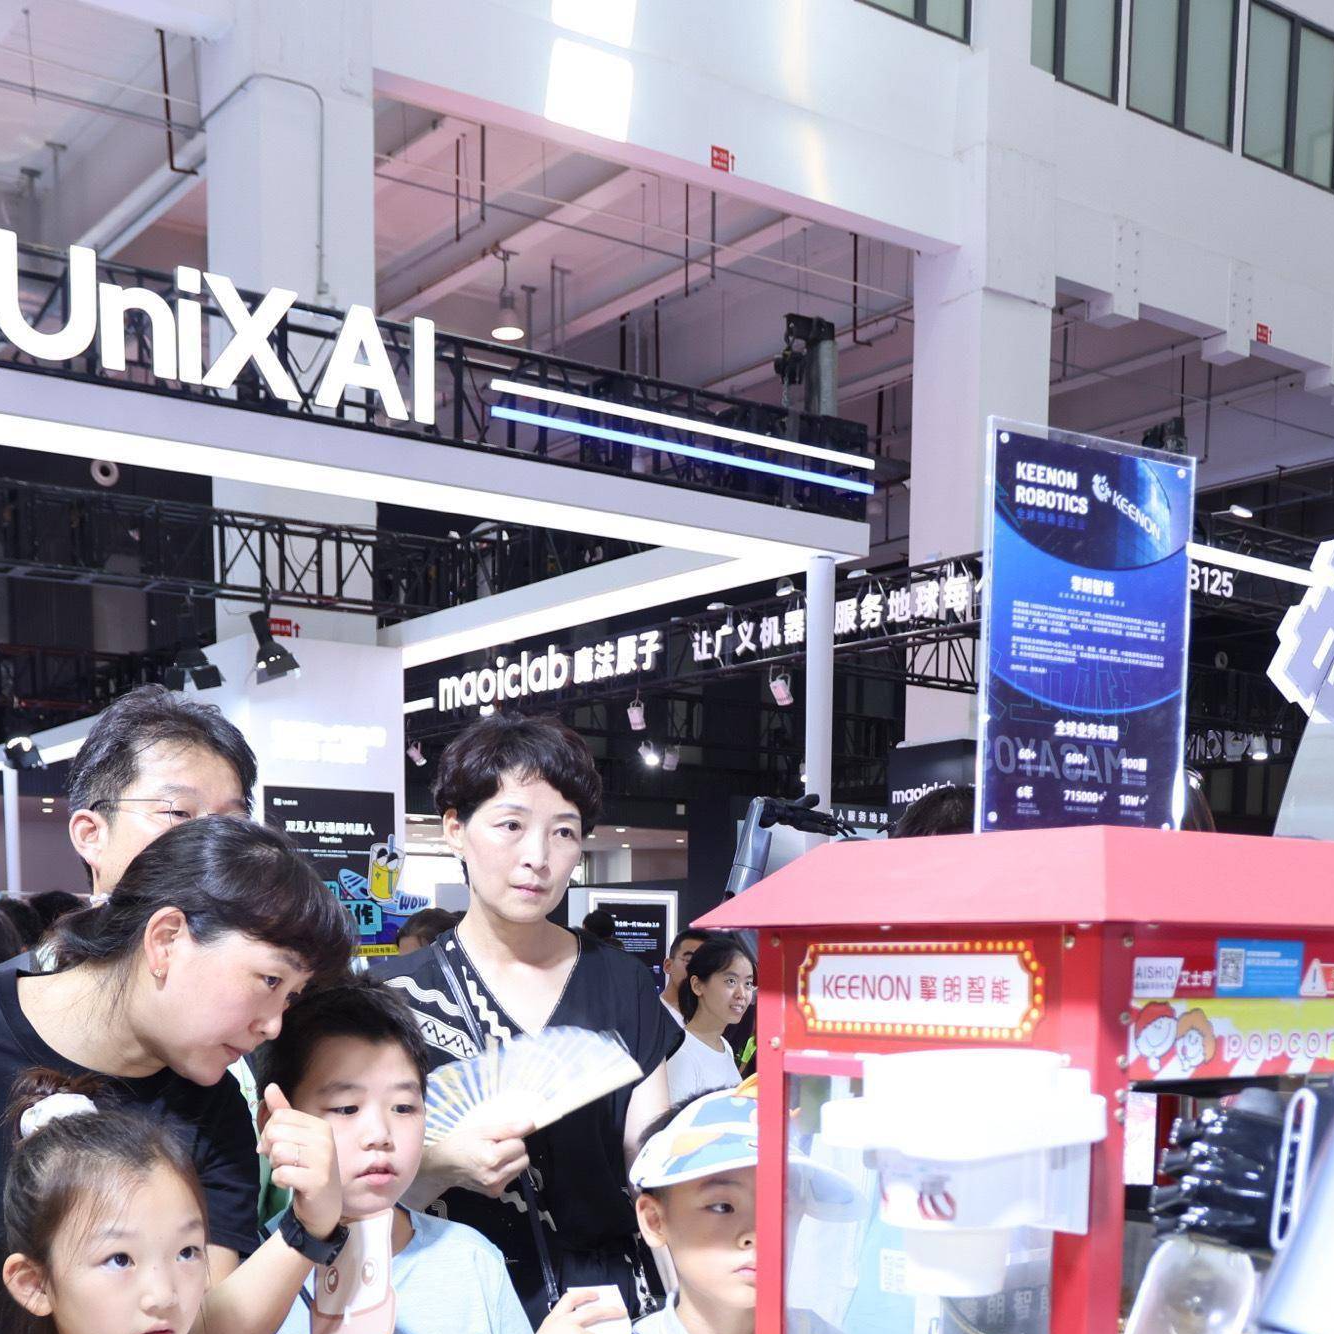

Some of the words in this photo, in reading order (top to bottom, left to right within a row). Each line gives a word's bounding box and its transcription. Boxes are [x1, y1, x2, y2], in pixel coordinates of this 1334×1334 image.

[1015, 460, 1078, 490] KEENON
[1014, 484, 1089, 515] ROBOTICS
[1112, 489, 1161, 541] KEENON
[573, 629, 663, 684] 魔法原子
[822, 974, 912, 1001] KEENON
[920, 975, 1011, 1004] 擎朗智能
